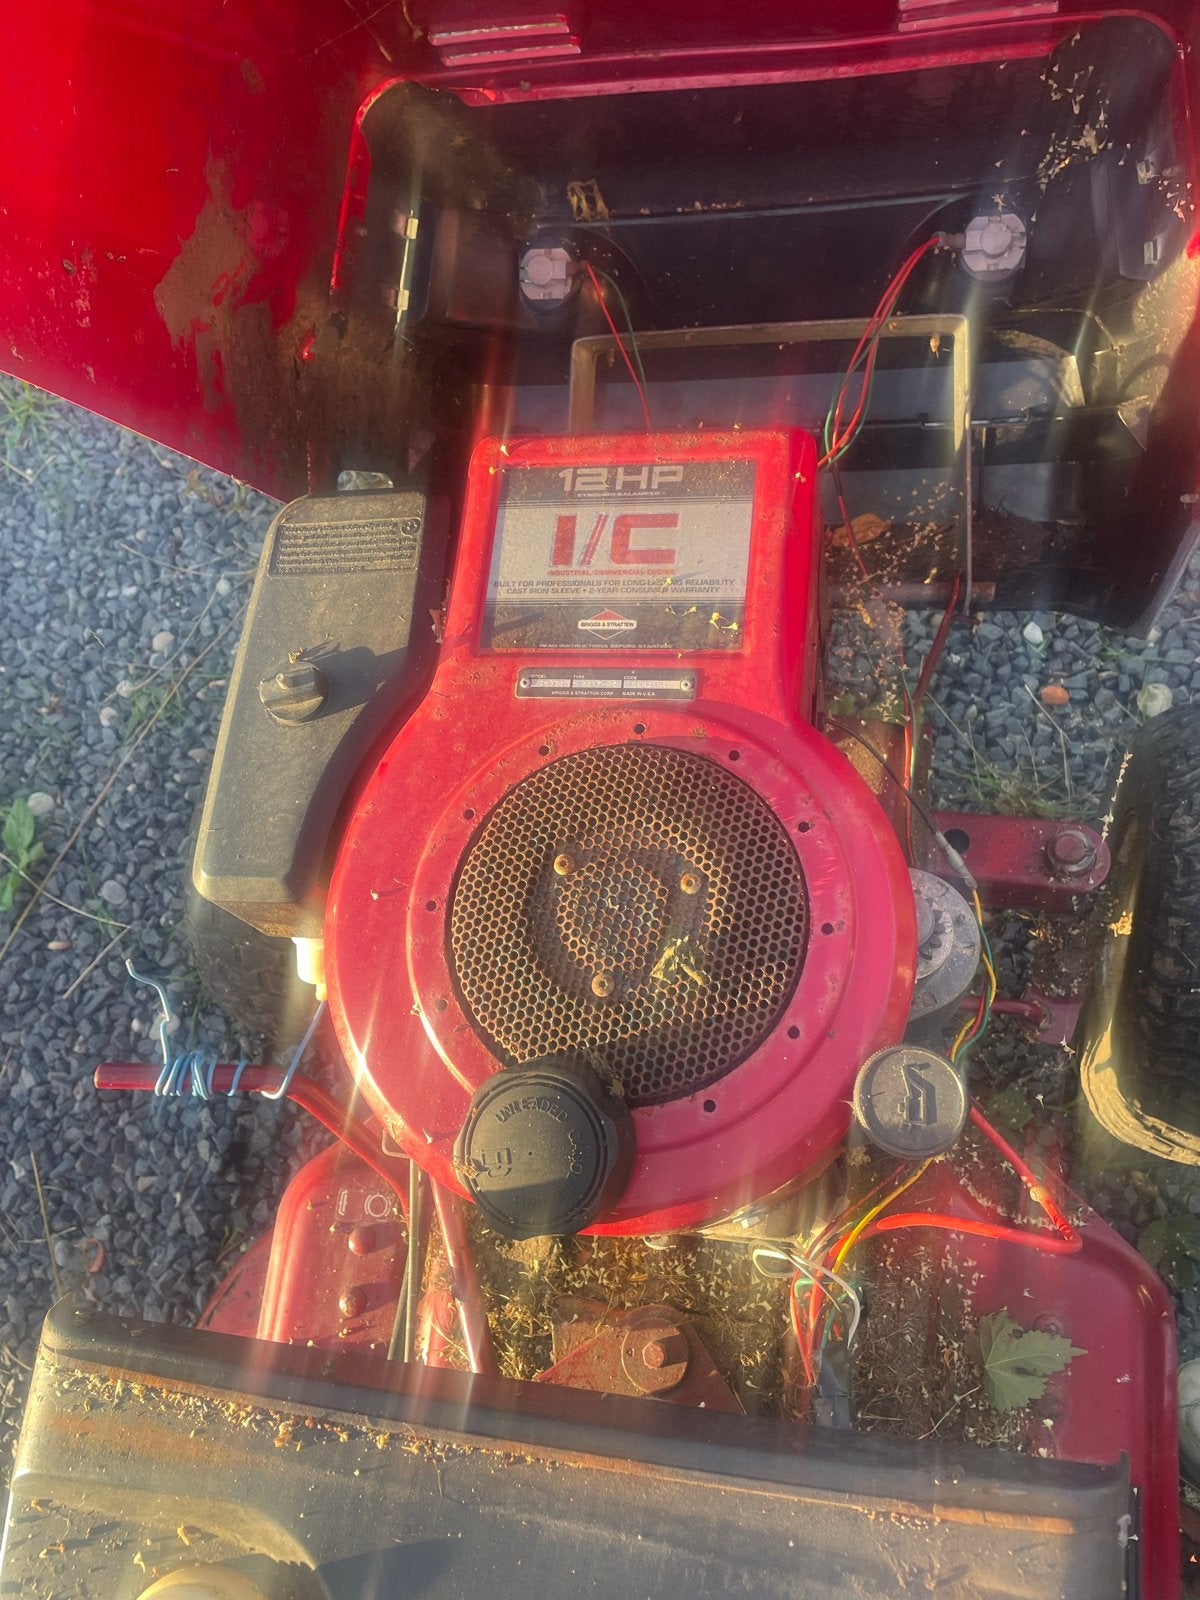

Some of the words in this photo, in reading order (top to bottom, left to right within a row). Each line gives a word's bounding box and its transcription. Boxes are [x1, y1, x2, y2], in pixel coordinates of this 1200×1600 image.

[559, 468, 608, 491] 12
[615, 466, 684, 490] HP
[549, 512, 680, 567] I/C
[685, 578, 735, 586] RELIABILITY
[495, 1096, 569, 1123] UNLEADED
